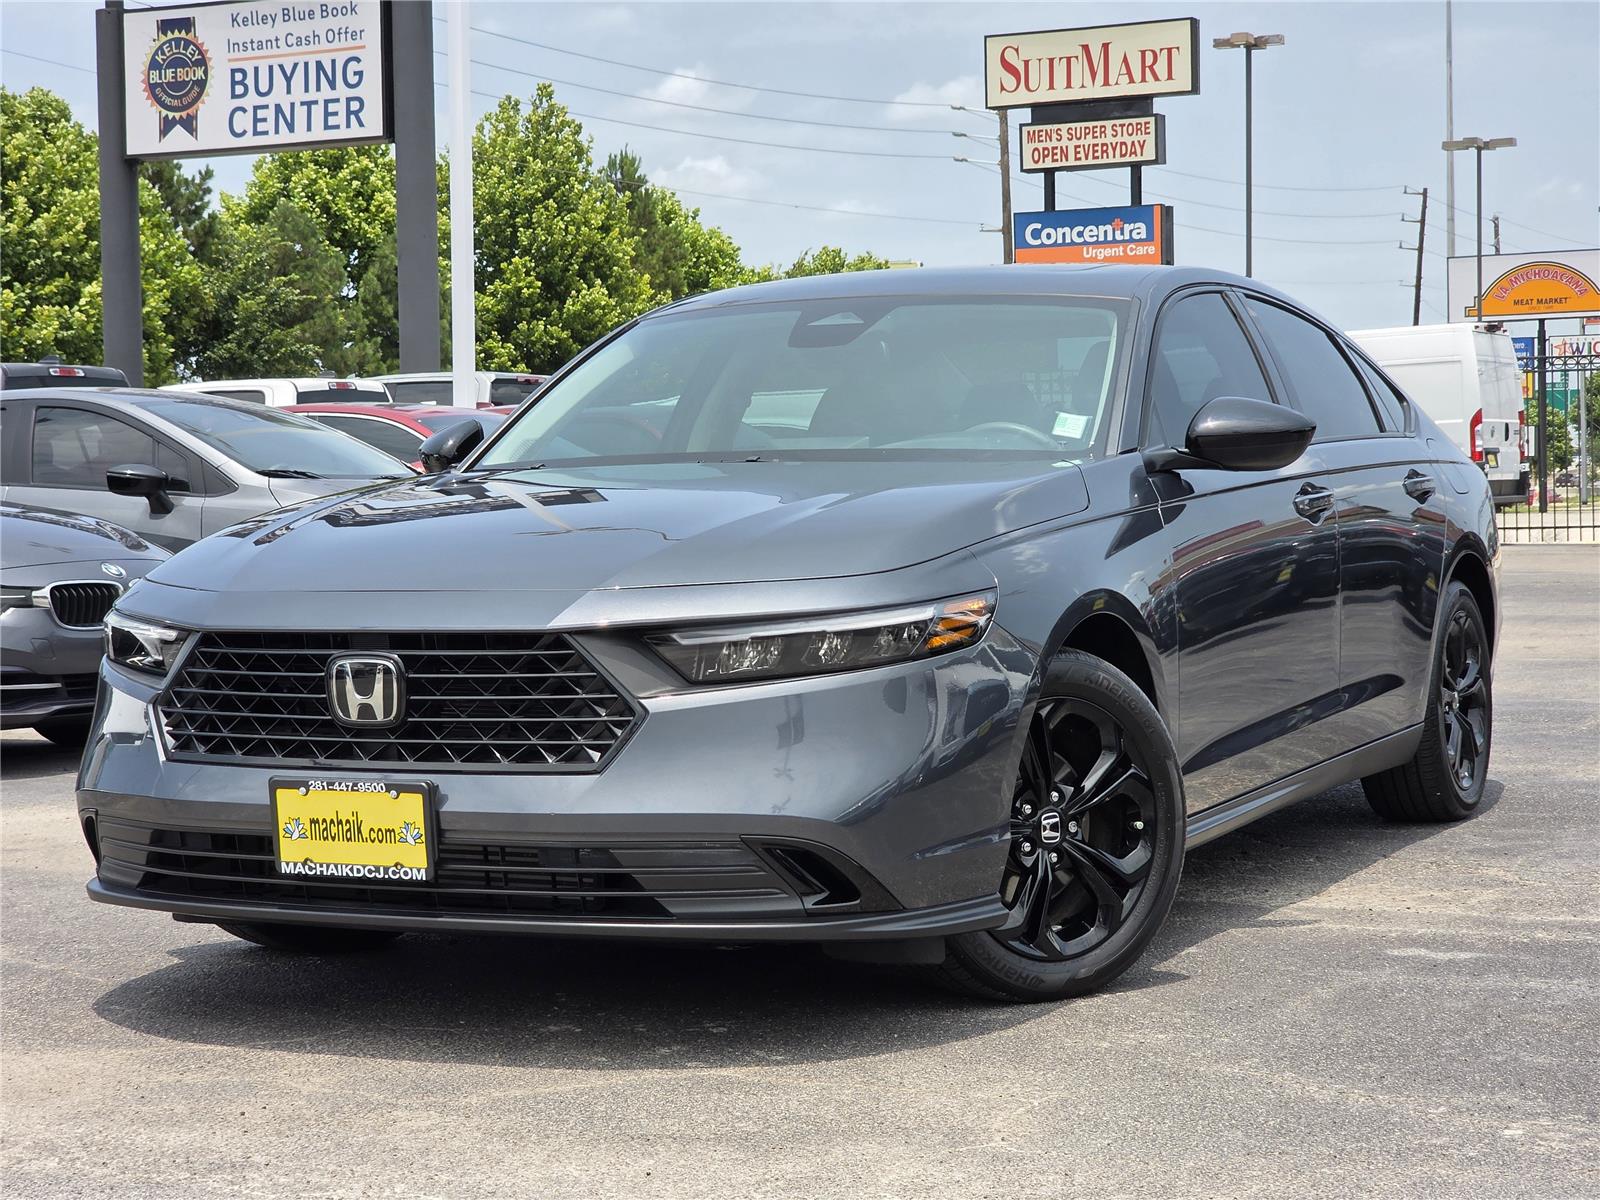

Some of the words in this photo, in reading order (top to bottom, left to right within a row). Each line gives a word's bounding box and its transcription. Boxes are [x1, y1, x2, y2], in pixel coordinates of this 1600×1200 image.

[231, 11, 278, 28] Kelley
[281, 6, 316, 23] Blue
[320, 1, 359, 19] Book
[227, 36, 281, 53] Instant
[284, 30, 321, 48] Cash
[325, 26, 365, 44] Offer
[155, 40, 202, 64] KELLEY
[149, 68, 176, 84] BLUE
[177, 66, 206, 82] BOOK
[230, 56, 365, 100] BUYING
[155, 87, 182, 107] OFFICIAL
[182, 85, 201, 105] GUIDE
[228, 96, 366, 139] CENTER
[1026, 127, 1063, 144] MEN'S
[1066, 124, 1107, 141] SUPER
[1111, 121, 1151, 138] STORE
[1031, 145, 1069, 164] OPEN
[1073, 139, 1147, 161] EVERYDAY
[1024, 219, 1147, 245] Concentra
[1083, 245, 1124, 260] Urgent
[1126, 243, 1156, 257] Care
[1509, 268, 1588, 296] MICHOACANA
[1513, 298, 1534, 306] MEAT
[1536, 296, 1568, 305] MARKET
[308, 780, 386, 793] 281-447-9500
[309, 811, 397, 844] machaik.com
[281, 861, 426, 881] MACHAIKDCJ.COM
